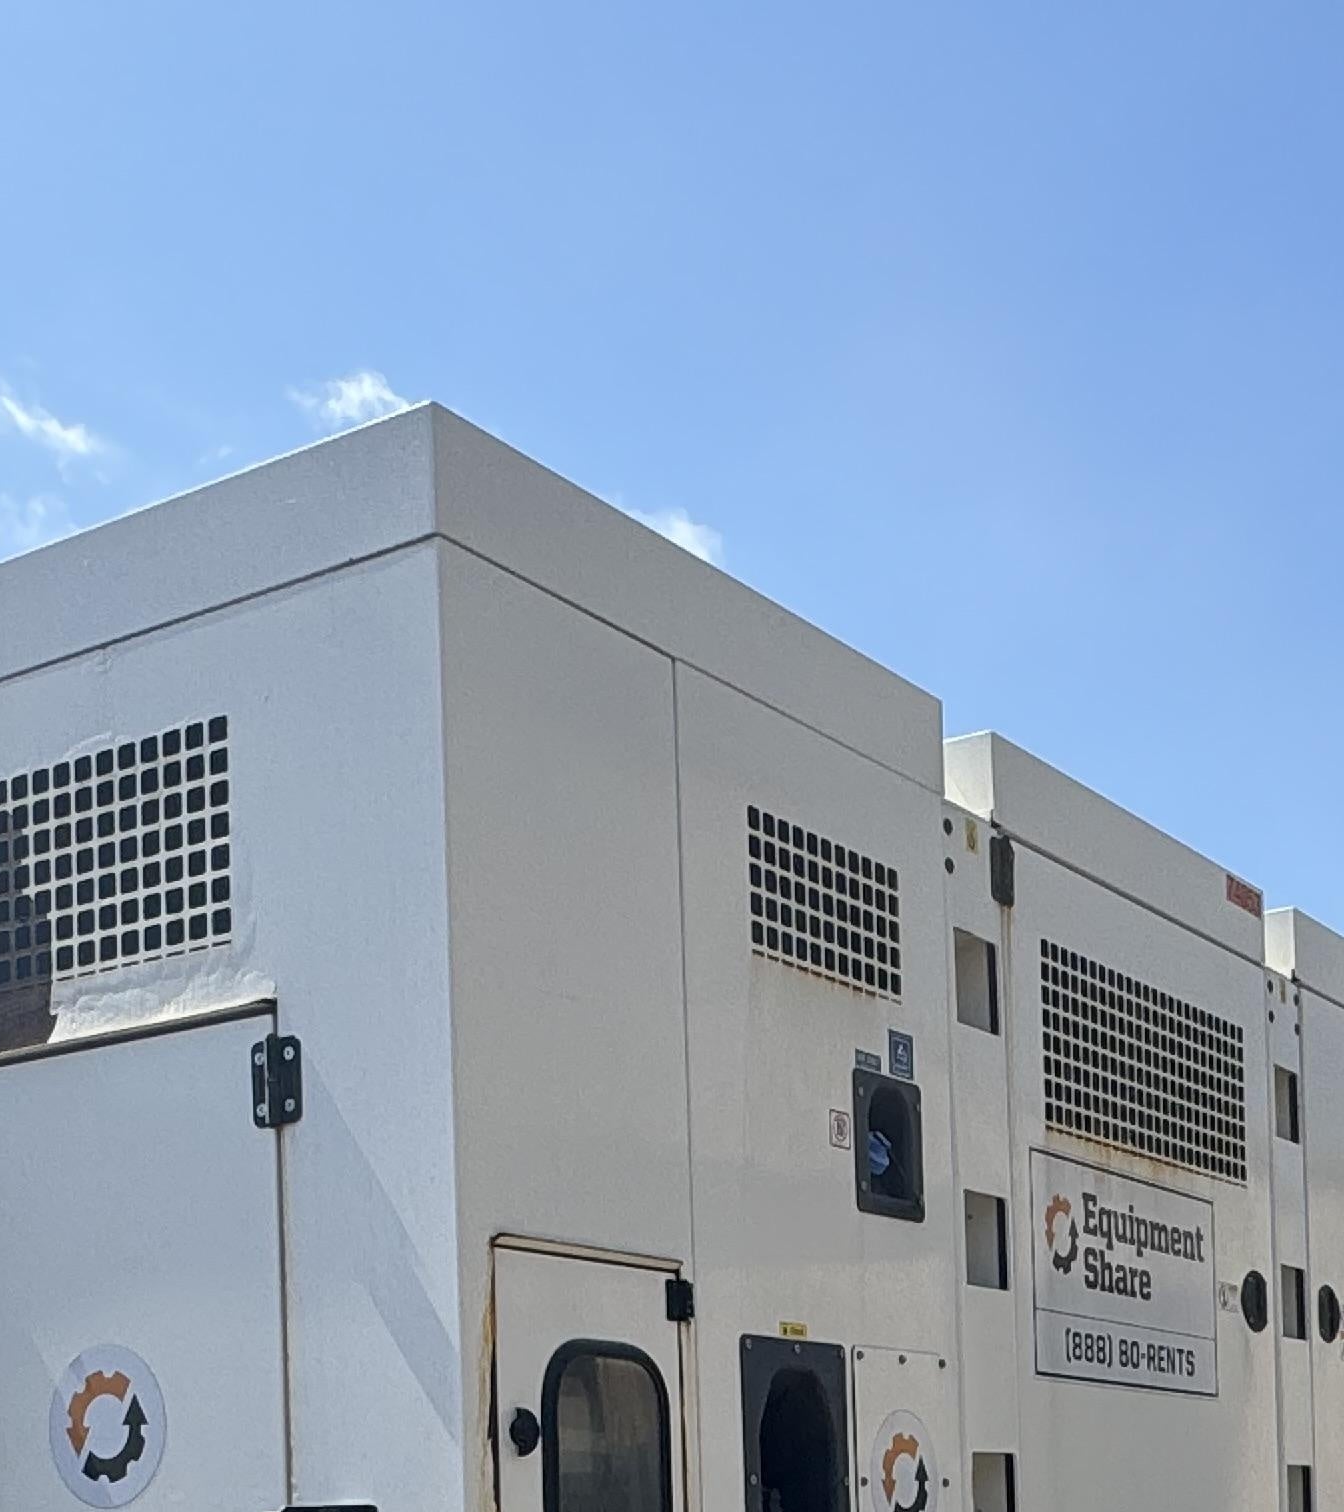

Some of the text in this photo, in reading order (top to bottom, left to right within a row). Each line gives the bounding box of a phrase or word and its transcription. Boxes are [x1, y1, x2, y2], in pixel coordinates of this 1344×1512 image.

[1082, 1192, 1205, 1263] Equipment
[1084, 1246, 1152, 1301] Share
[1065, 1327, 1196, 1377] (888) 80-RENTS
